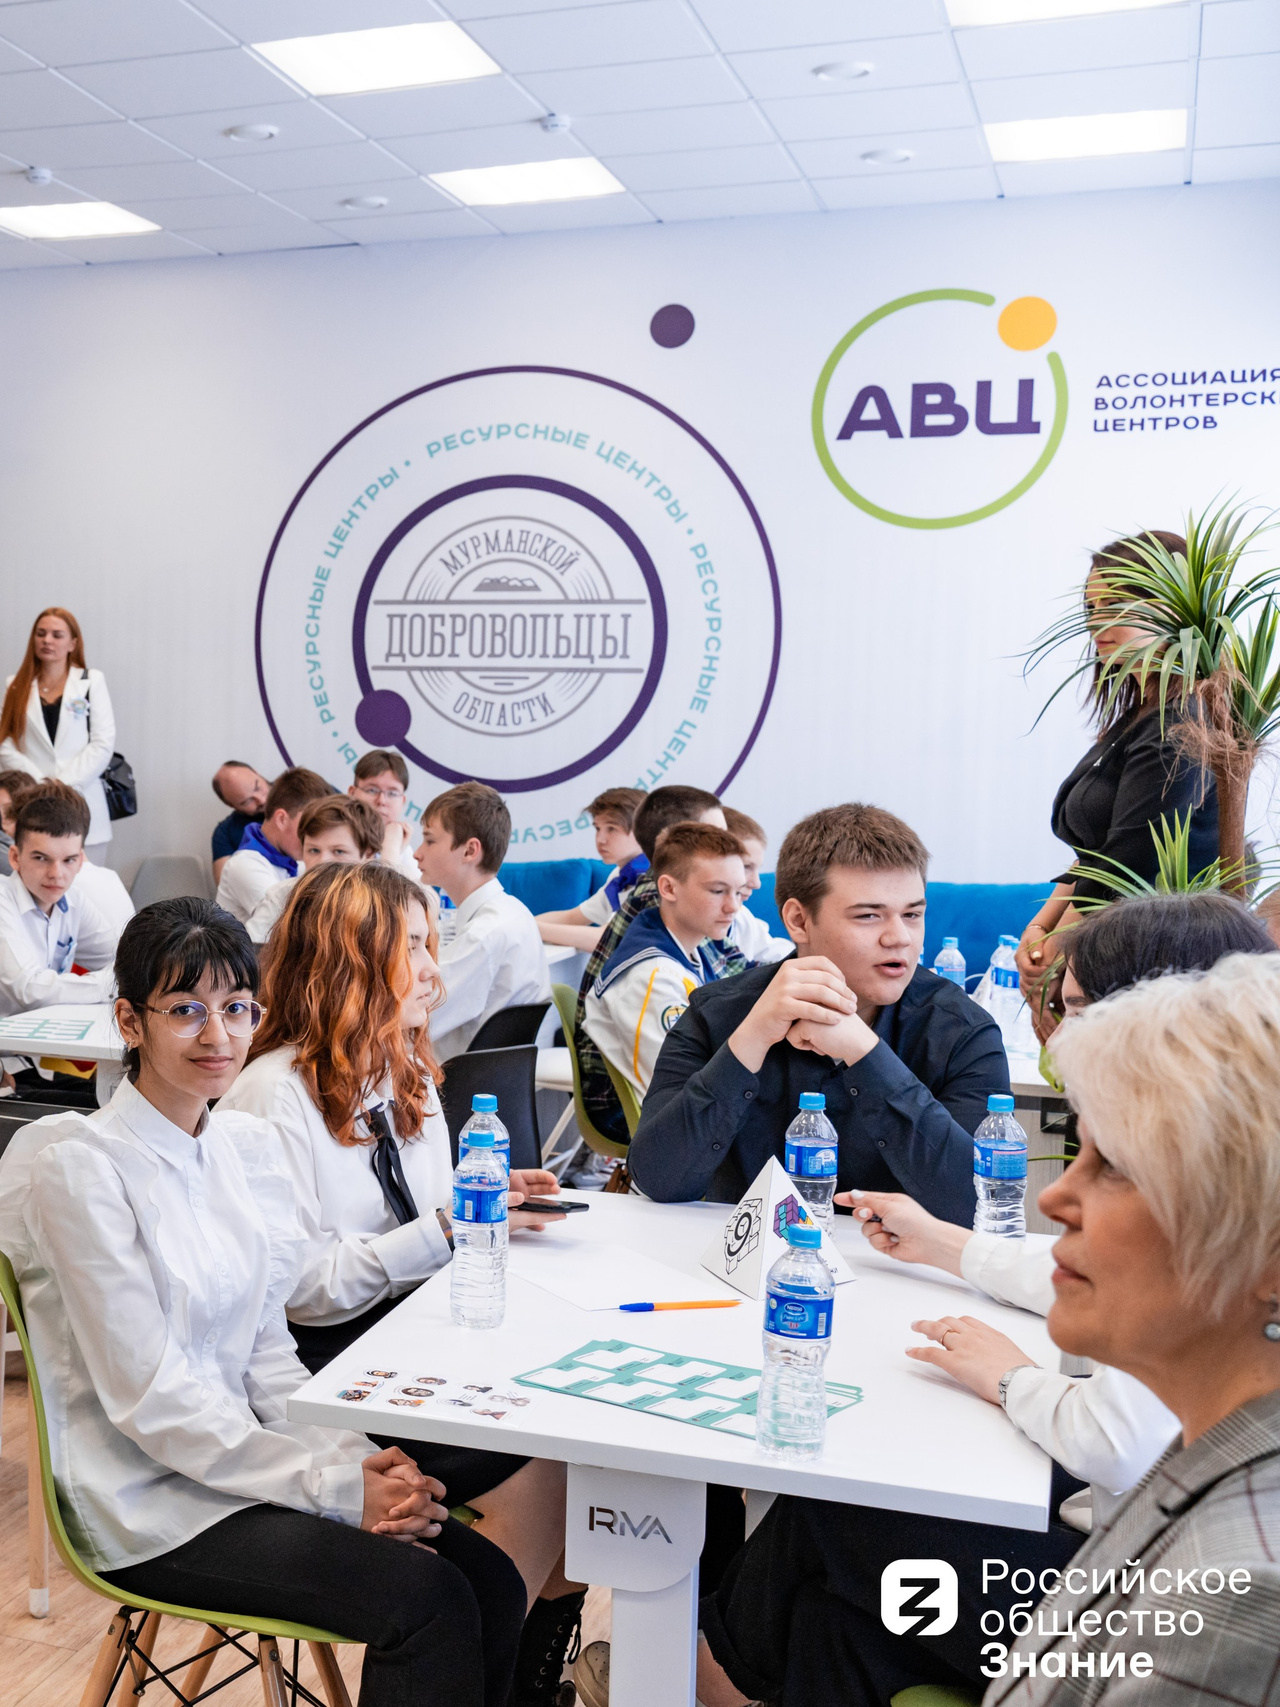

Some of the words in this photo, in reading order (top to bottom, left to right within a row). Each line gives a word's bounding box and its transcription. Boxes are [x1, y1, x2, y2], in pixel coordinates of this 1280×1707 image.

[1094, 391, 1280, 411] ВОЛОНТЕРСК
[1096, 368, 1280, 389] АССОЦИАЦИЯ
[836, 378, 1041, 440] АВЦ
[1093, 416, 1218, 432] ЦЕНТРОВ
[426, 423, 590, 458] РЕСУРСНЫЕ
[595, 441, 689, 523] ЦЕНТРЫ
[439, 529, 581, 577] МУРМАНСКОЙ
[305, 565, 335, 724] РЕСУРСНЫЕ
[324, 466, 400, 560] ЦЕНТРЫ
[385, 613, 632, 664] ДОБРОВОЛЬЦЫ
[690, 543, 722, 713] РЕСУРСНЫЕ
[453, 692, 555, 727] ОБЛАСТИ
[634, 719, 698, 791] ЦЕНТР
[727, 1212, 752, 1257] 9
[589, 1506, 673, 1544] RIVA
